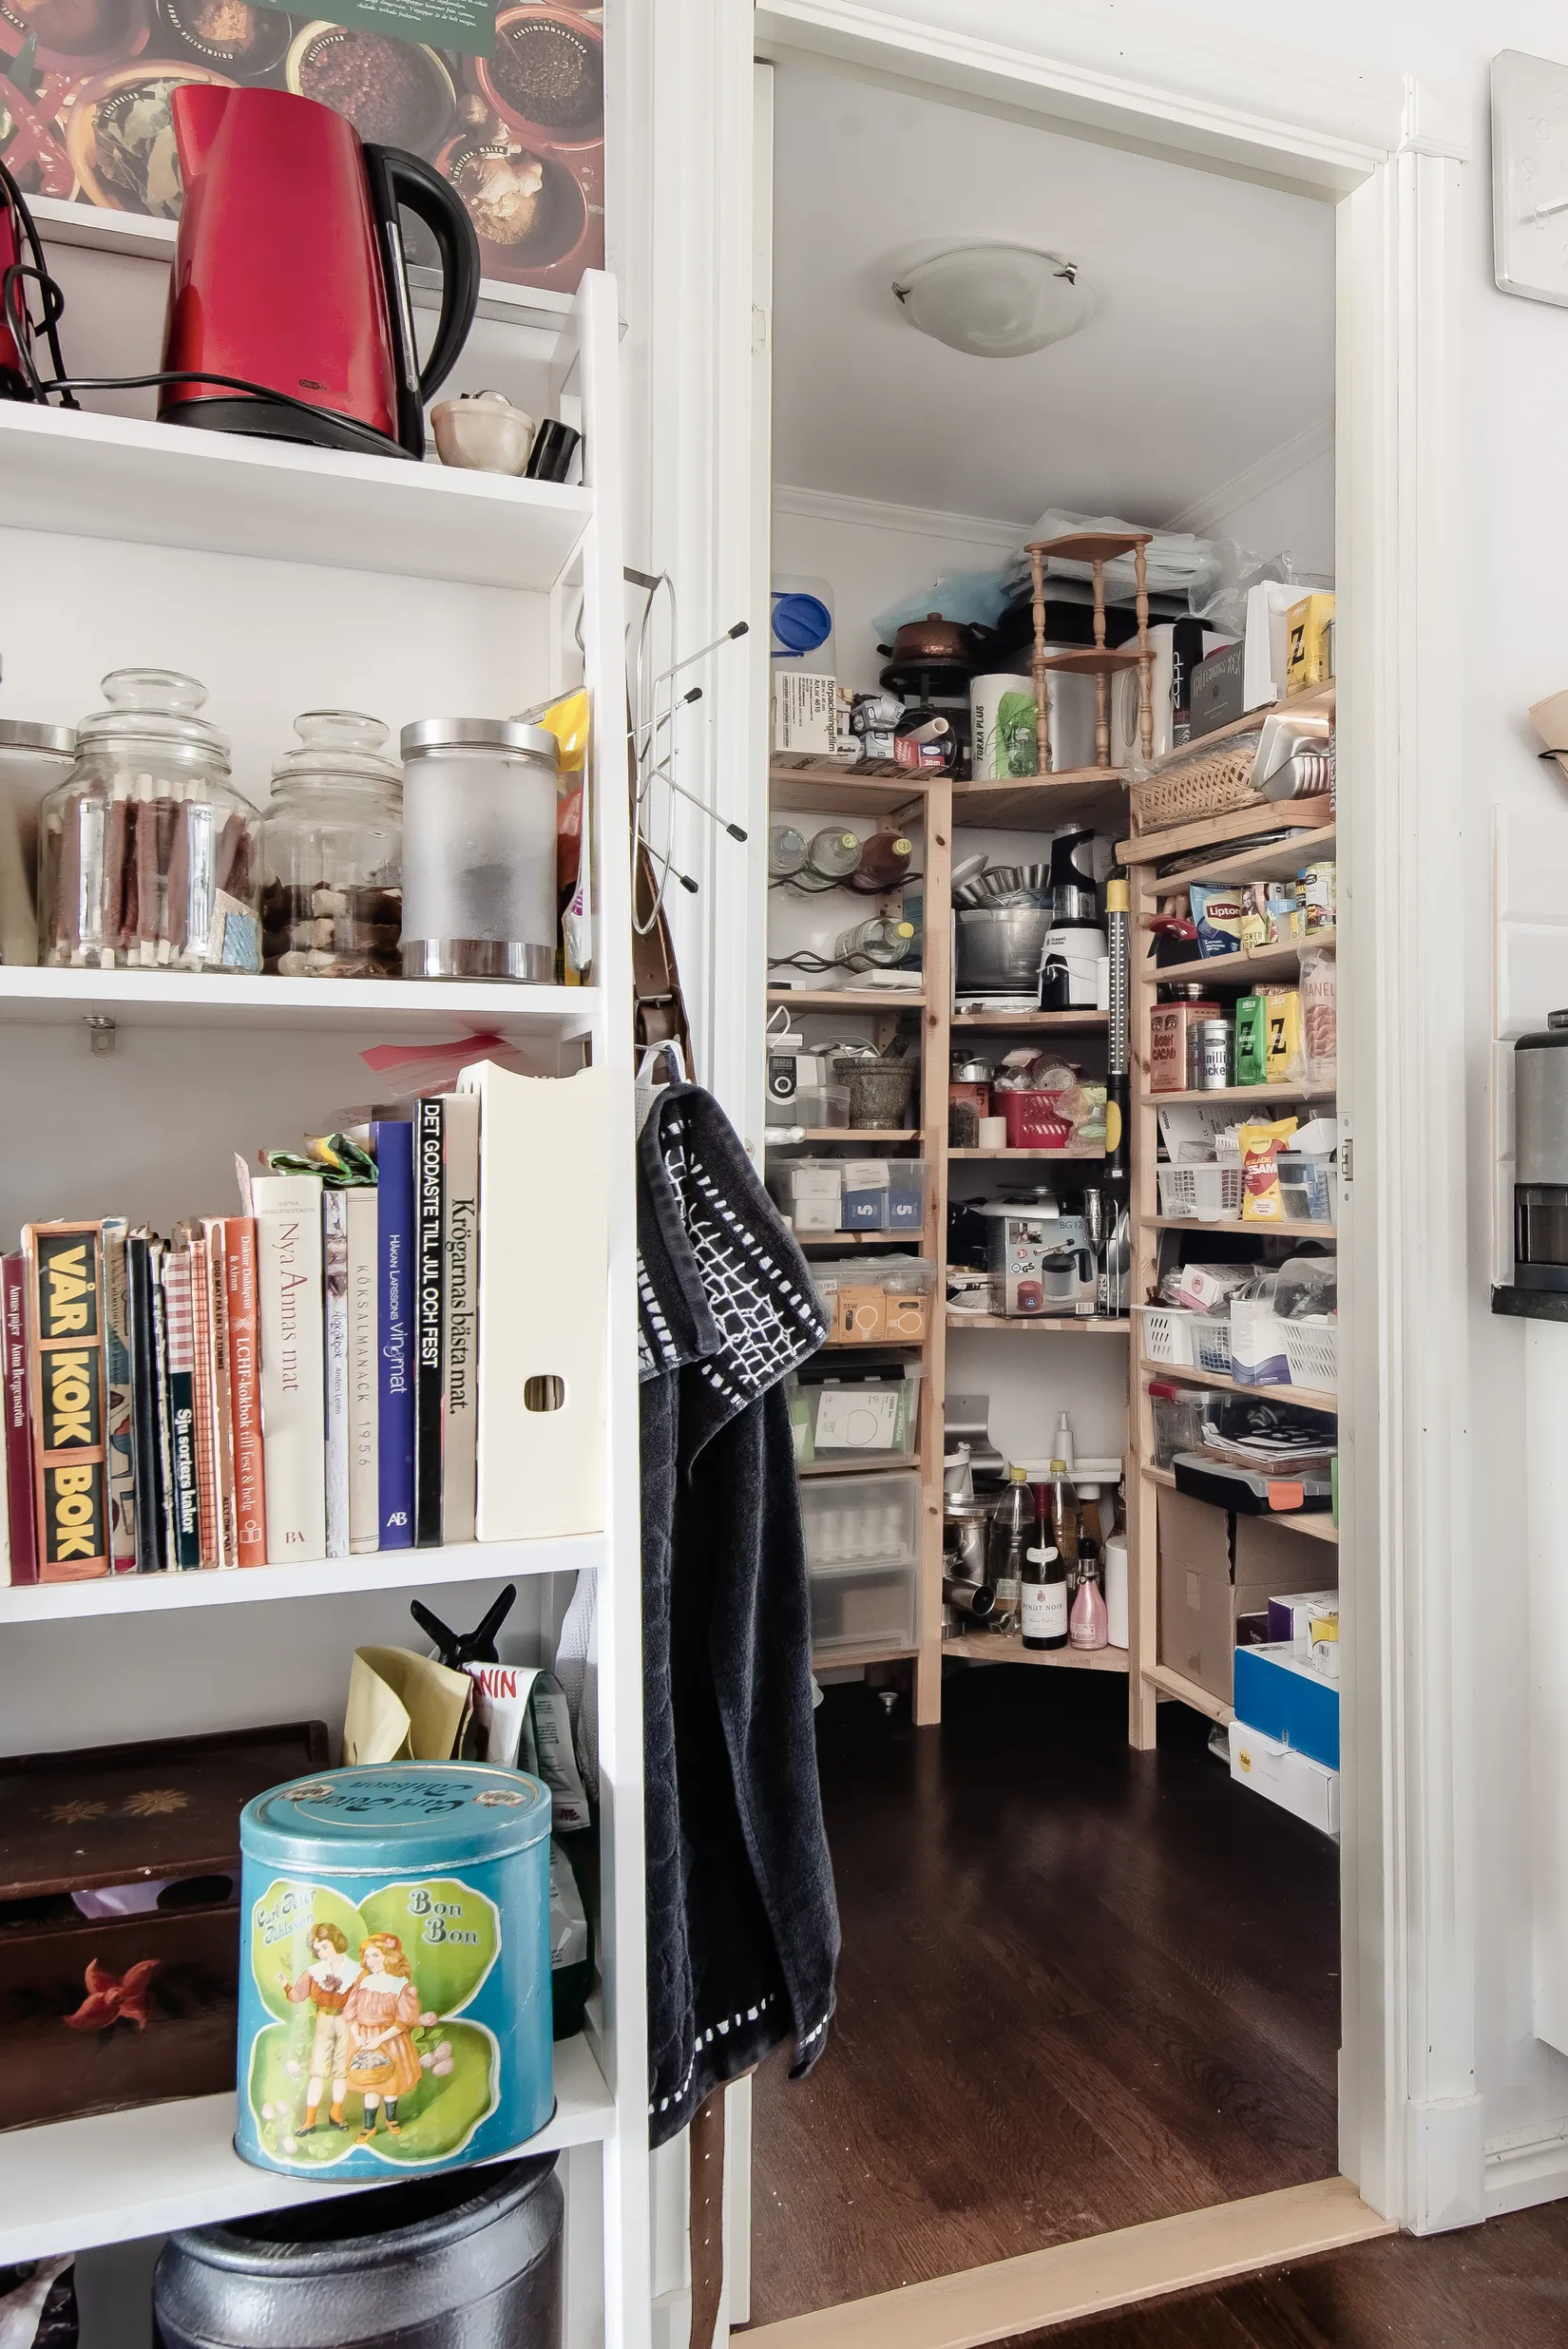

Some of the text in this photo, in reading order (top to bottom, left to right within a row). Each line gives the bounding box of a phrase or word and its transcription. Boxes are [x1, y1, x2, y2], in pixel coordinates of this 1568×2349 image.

[166, 3, 234, 60] ORIENTALISK CURRY
[103, 91, 140, 118] LAGERBLAD
[479, 146, 505, 155] MALEN
[826, 679, 836, 752] förpackningsfilm
[975, 705, 985, 729] PLUS
[1209, 906, 1241, 917] Lipton
[1152, 1048, 1176, 1061] CACAO
[1161, 1110, 1170, 1130] BOSCH
[421, 1104, 440, 1369] DET GODASTE TILL JUL OCH FEST
[1060, 1220, 1073, 1230] BG
[389, 1234, 401, 1268] HÅKAN
[240, 1235, 253, 1308] Doktor Dahlqvist
[214, 1279, 222, 1299] MAT
[389, 1270, 400, 1321] LARSSONS
[216, 1313, 222, 1324] EN
[272, 1222, 309, 1392] Nya Annas mat
[445, 1197, 475, 1415] Krögarnas bästa mat.
[8, 1285, 25, 1427] Annas pajer Anna Bergenström
[355, 1265, 372, 1466] KÖKSALMANACK 1956
[335, 1366, 343, 1392] Anders
[48, 1244, 96, 1561] VÅR KOK BOK
[236, 1337, 256, 1512] LCHF-kokbok till fest & helg
[175, 1408, 197, 1535] Sju sorters kakor
[222, 1518, 230, 1531] OM
[386, 1511, 408, 1527] AB
[285, 1531, 306, 1544] BA
[1023, 1602, 1063, 1612] PINOT NOIR
[468, 1668, 516, 1699] NIN
[1238, 1751, 1251, 1767] Yale
[257, 1888, 316, 1929] Carl Peter
[408, 1888, 464, 1917] Bon
[423, 1916, 479, 1944] Bon
